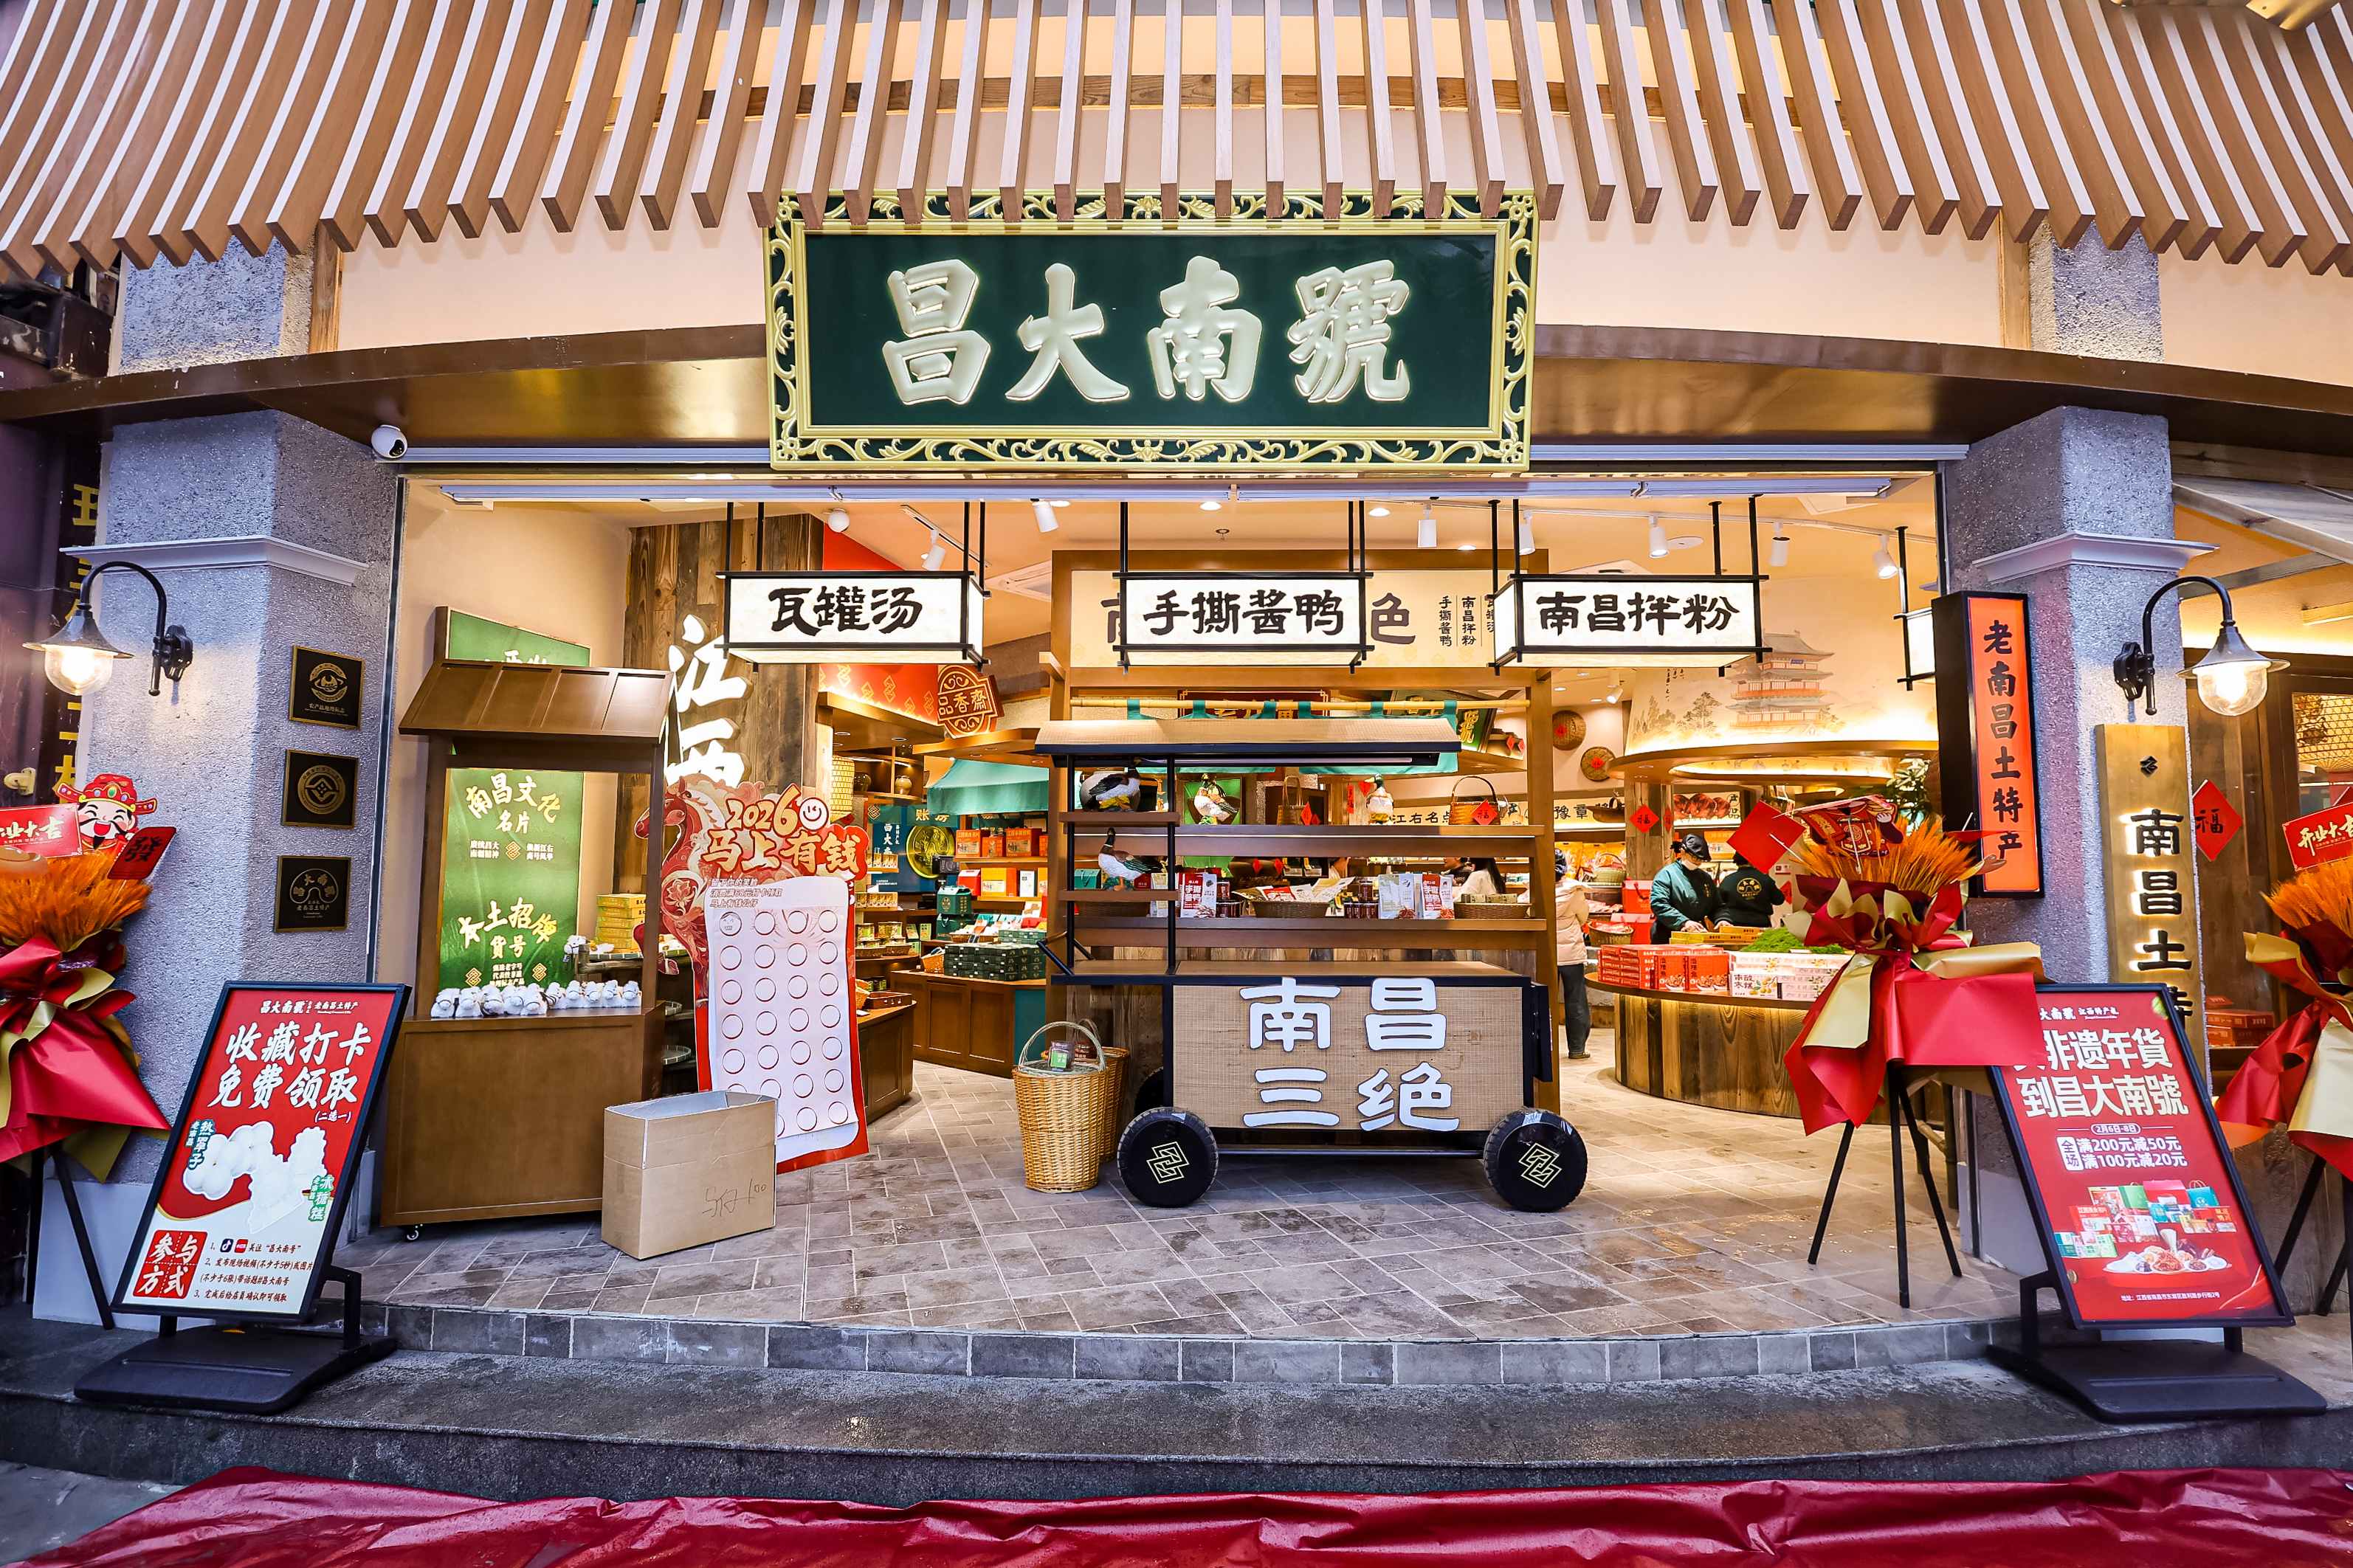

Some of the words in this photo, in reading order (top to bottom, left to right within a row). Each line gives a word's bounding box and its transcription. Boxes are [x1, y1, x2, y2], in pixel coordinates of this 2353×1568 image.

[882, 255, 1413, 407] 昌大南號
[768, 586, 923, 637] 瓦罐汤
[1143, 589, 1344, 636] 手撕酱鸭
[1439, 595, 1453, 647] 手撕酱鸭
[1461, 596, 1476, 646] 南昌拌粉
[1536, 591, 1741, 636] 南昌拌粉
[1983, 620, 2024, 860] 老南昌土特产
[466, 772, 561, 823] 南昌文化
[726, 784, 801, 837] 2026
[1477, 810, 1489, 819] 福
[0, 816, 65, 840] 业大吉
[495, 809, 530, 834] 名片
[1637, 814, 1650, 824] 福
[2196, 809, 2224, 834] 福
[124, 836, 163, 862] 發
[703, 829, 861, 874] 马上有钱
[1185, 885, 1202, 893] 手撕
[314, 1001, 359, 1010] 老南昌土特产
[1239, 977, 1447, 1052] 南昌
[225, 1020, 372, 1066] 收藏打卡
[2015, 1028, 2173, 1070] 非遗年貨
[207, 1063, 358, 1110] 免费领取
[1242, 1061, 1460, 1132] 三绝
[2016, 1073, 2189, 1119] 到昌大南號
[185, 1121, 201, 1147] 老南昌
[2076, 1136, 2183, 1154] 满200元减50元
[2095, 1125, 2137, 1133] 2月6日-8日
[2061, 1140, 2079, 1167] 全场
[2082, 1152, 2188, 1169] 满100元减20元
[309, 1176, 321, 1201] 老南昌
[149, 1232, 199, 1263] 参与
[137, 1265, 189, 1297] 方式
